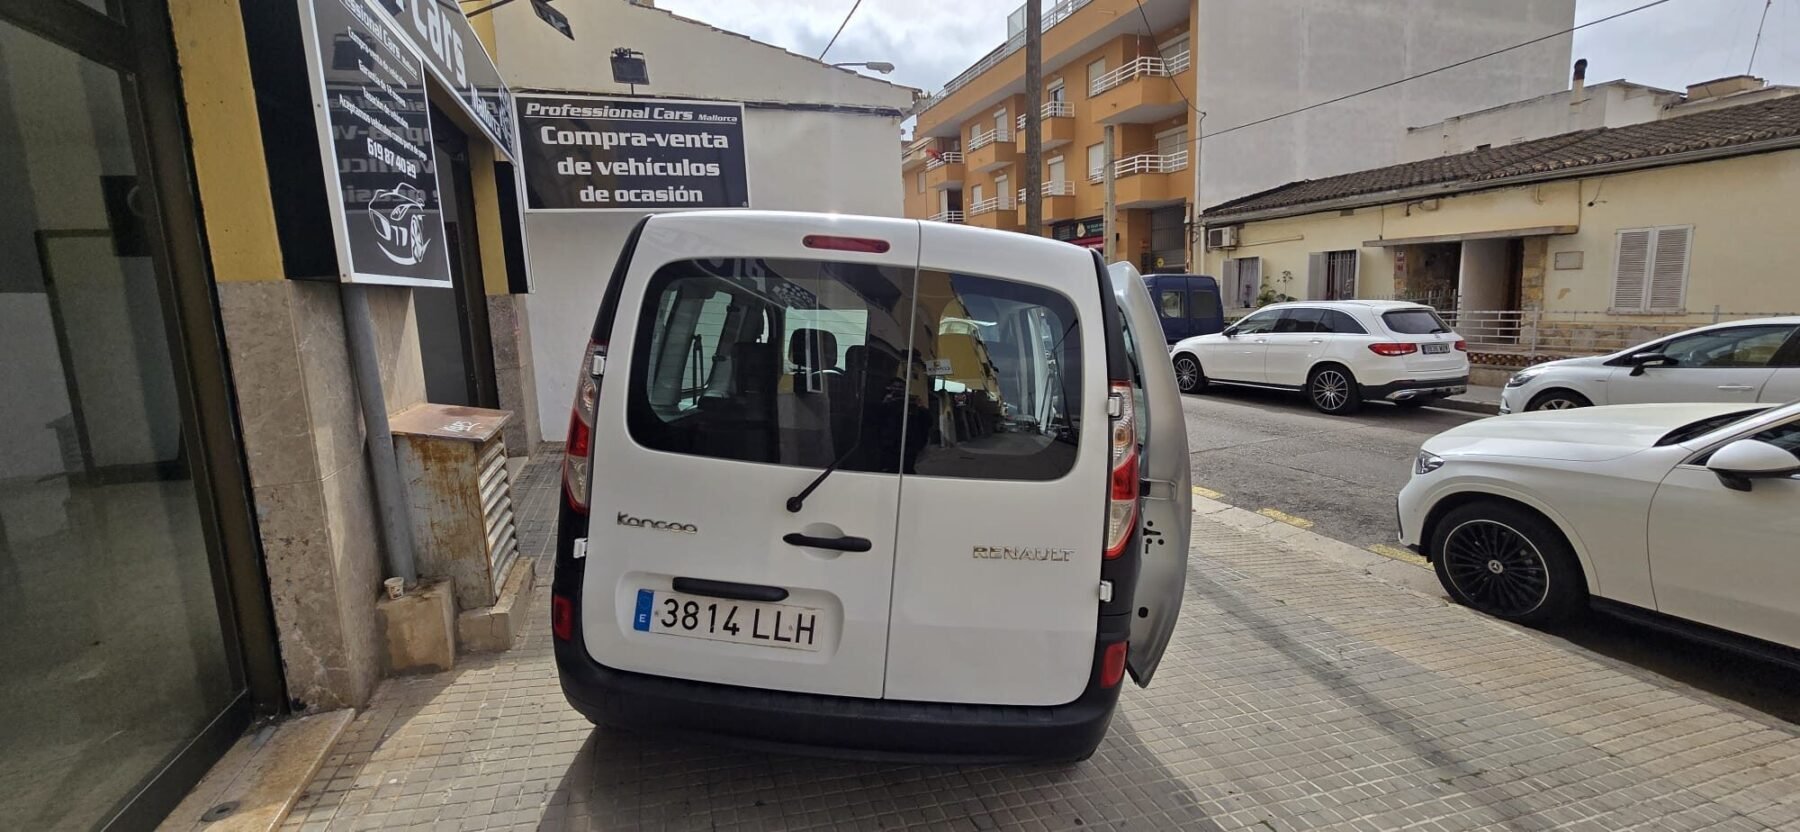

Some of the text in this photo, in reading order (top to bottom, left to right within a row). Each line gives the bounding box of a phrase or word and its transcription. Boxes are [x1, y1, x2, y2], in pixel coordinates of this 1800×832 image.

[383, 29, 401, 60] Cars
[525, 102, 738, 123] Professional Cars Mallorca
[540, 126, 729, 150] Compra-venta
[367, 137, 384, 161] 619
[384, 147, 395, 167] 87
[395, 155, 407, 174] 40
[406, 160, 417, 179] 29
[557, 157, 720, 177] de vehículos
[580, 185, 704, 203] de ocasión
[973, 546, 1075, 562] RENAULT
[639, 613, 647, 623] E
[661, 598, 816, 645] 3814 LLH
